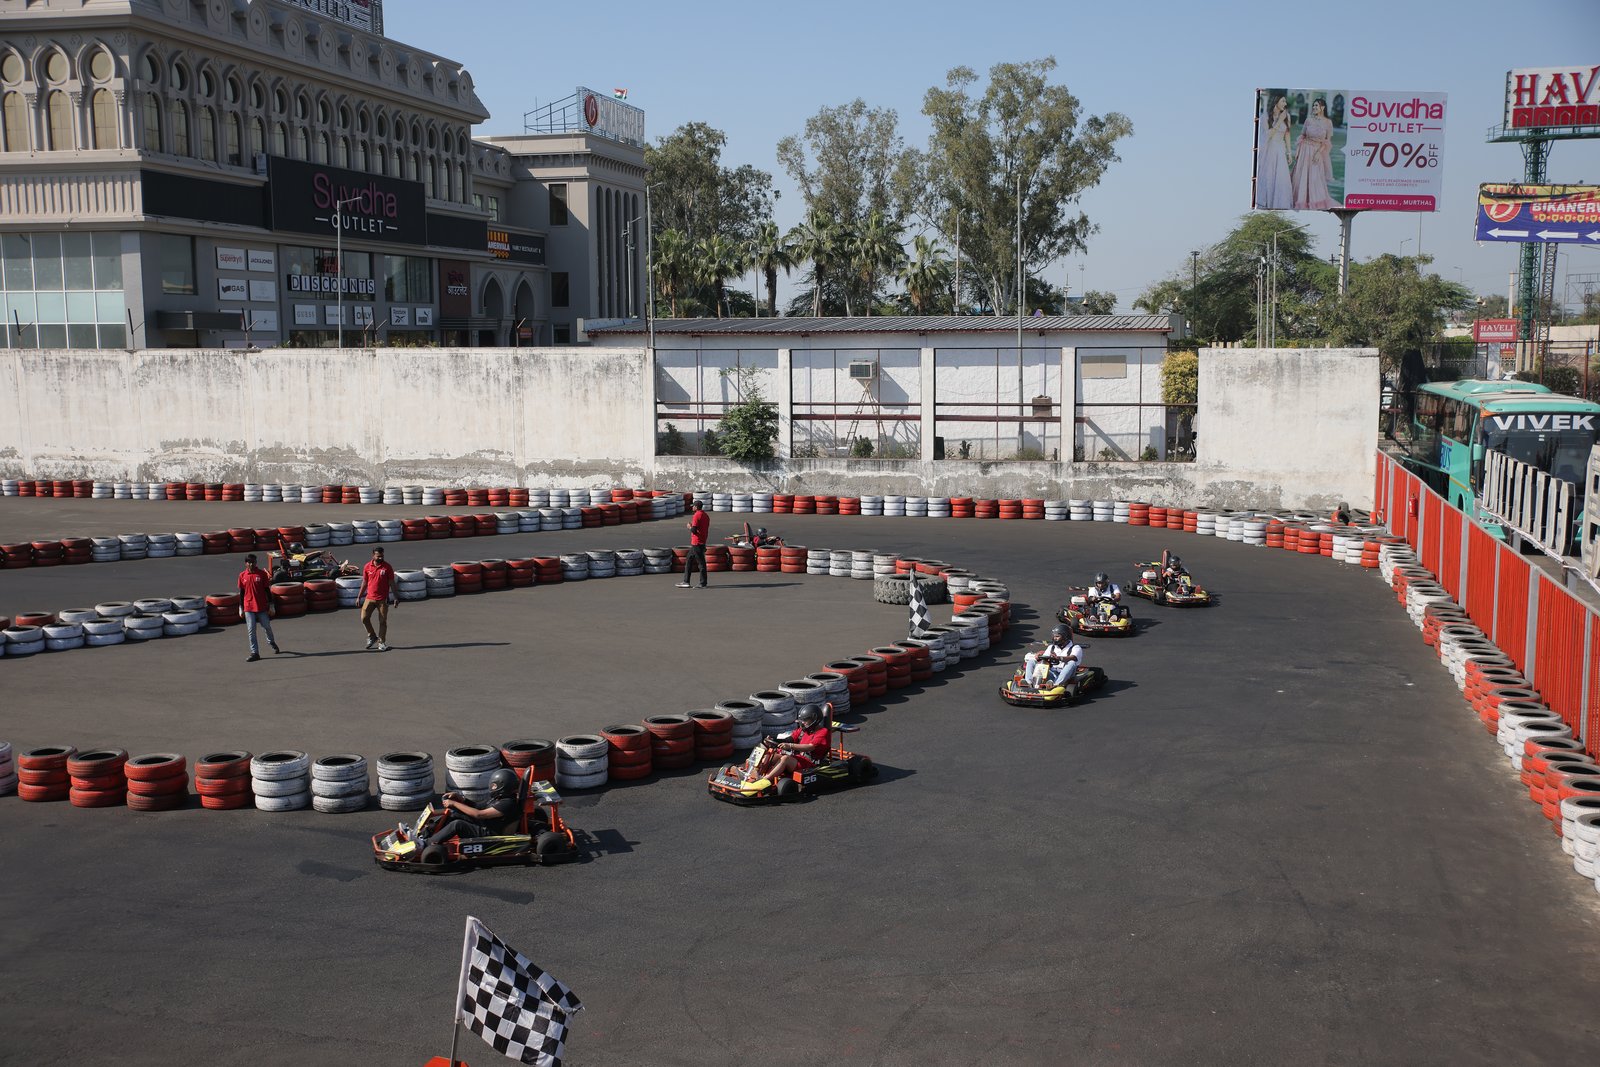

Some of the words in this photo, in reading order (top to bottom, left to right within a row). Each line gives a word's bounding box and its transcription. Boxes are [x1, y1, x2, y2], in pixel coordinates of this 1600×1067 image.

[1513, 66, 1600, 106] HAV
[1367, 122, 1424, 133] OUTLET
[1350, 149, 1371, 157] UPTO
[1363, 142, 1427, 168] 70%
[1428, 143, 1438, 168] OFF
[313, 172, 397, 218] Suvidha
[331, 214, 384, 233] OUTLET
[292, 275, 374, 293] DISCOUNTS
[1492, 414, 1595, 430] VIVEK
[803, 775, 817, 784] 26
[463, 845, 483, 853] 28
